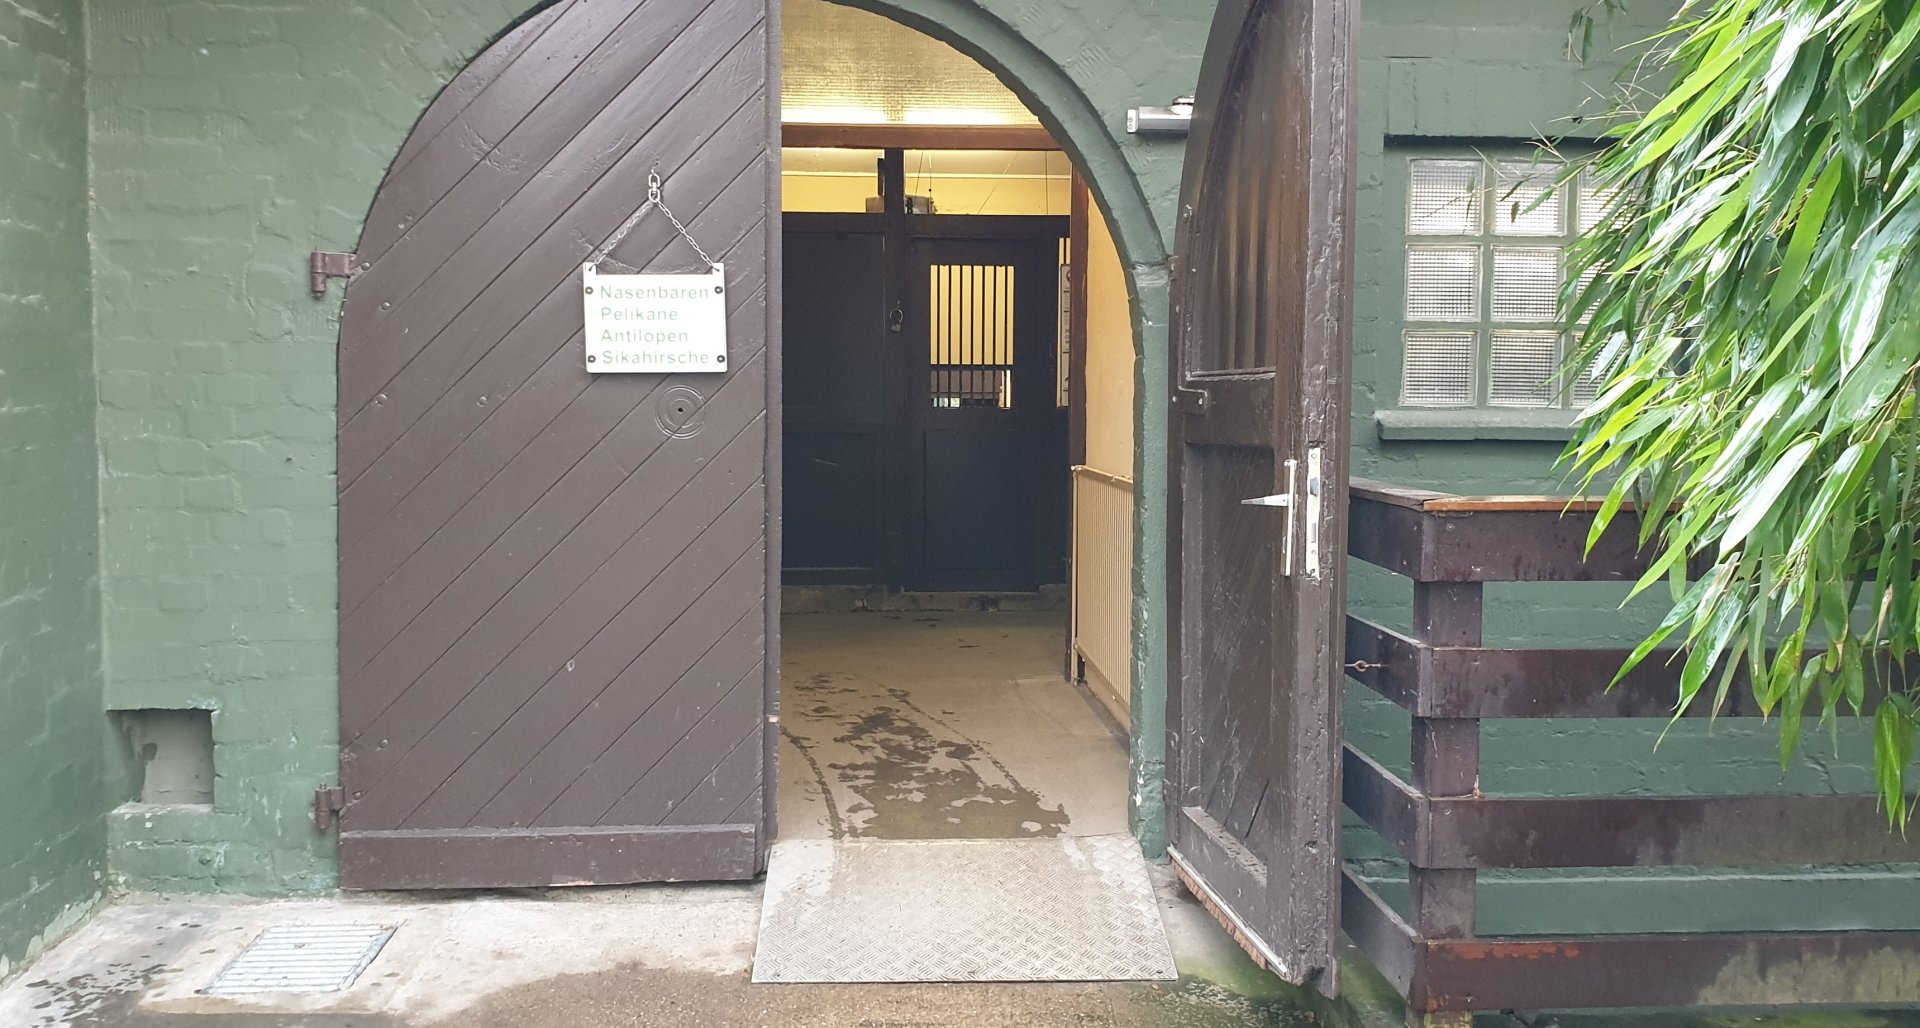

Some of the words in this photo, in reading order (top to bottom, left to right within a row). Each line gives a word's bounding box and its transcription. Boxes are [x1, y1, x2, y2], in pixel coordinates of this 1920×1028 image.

[601, 306, 678, 321] Pelikane
[601, 328, 688, 344] Antilopen
[602, 350, 709, 364] Sikahirsche
